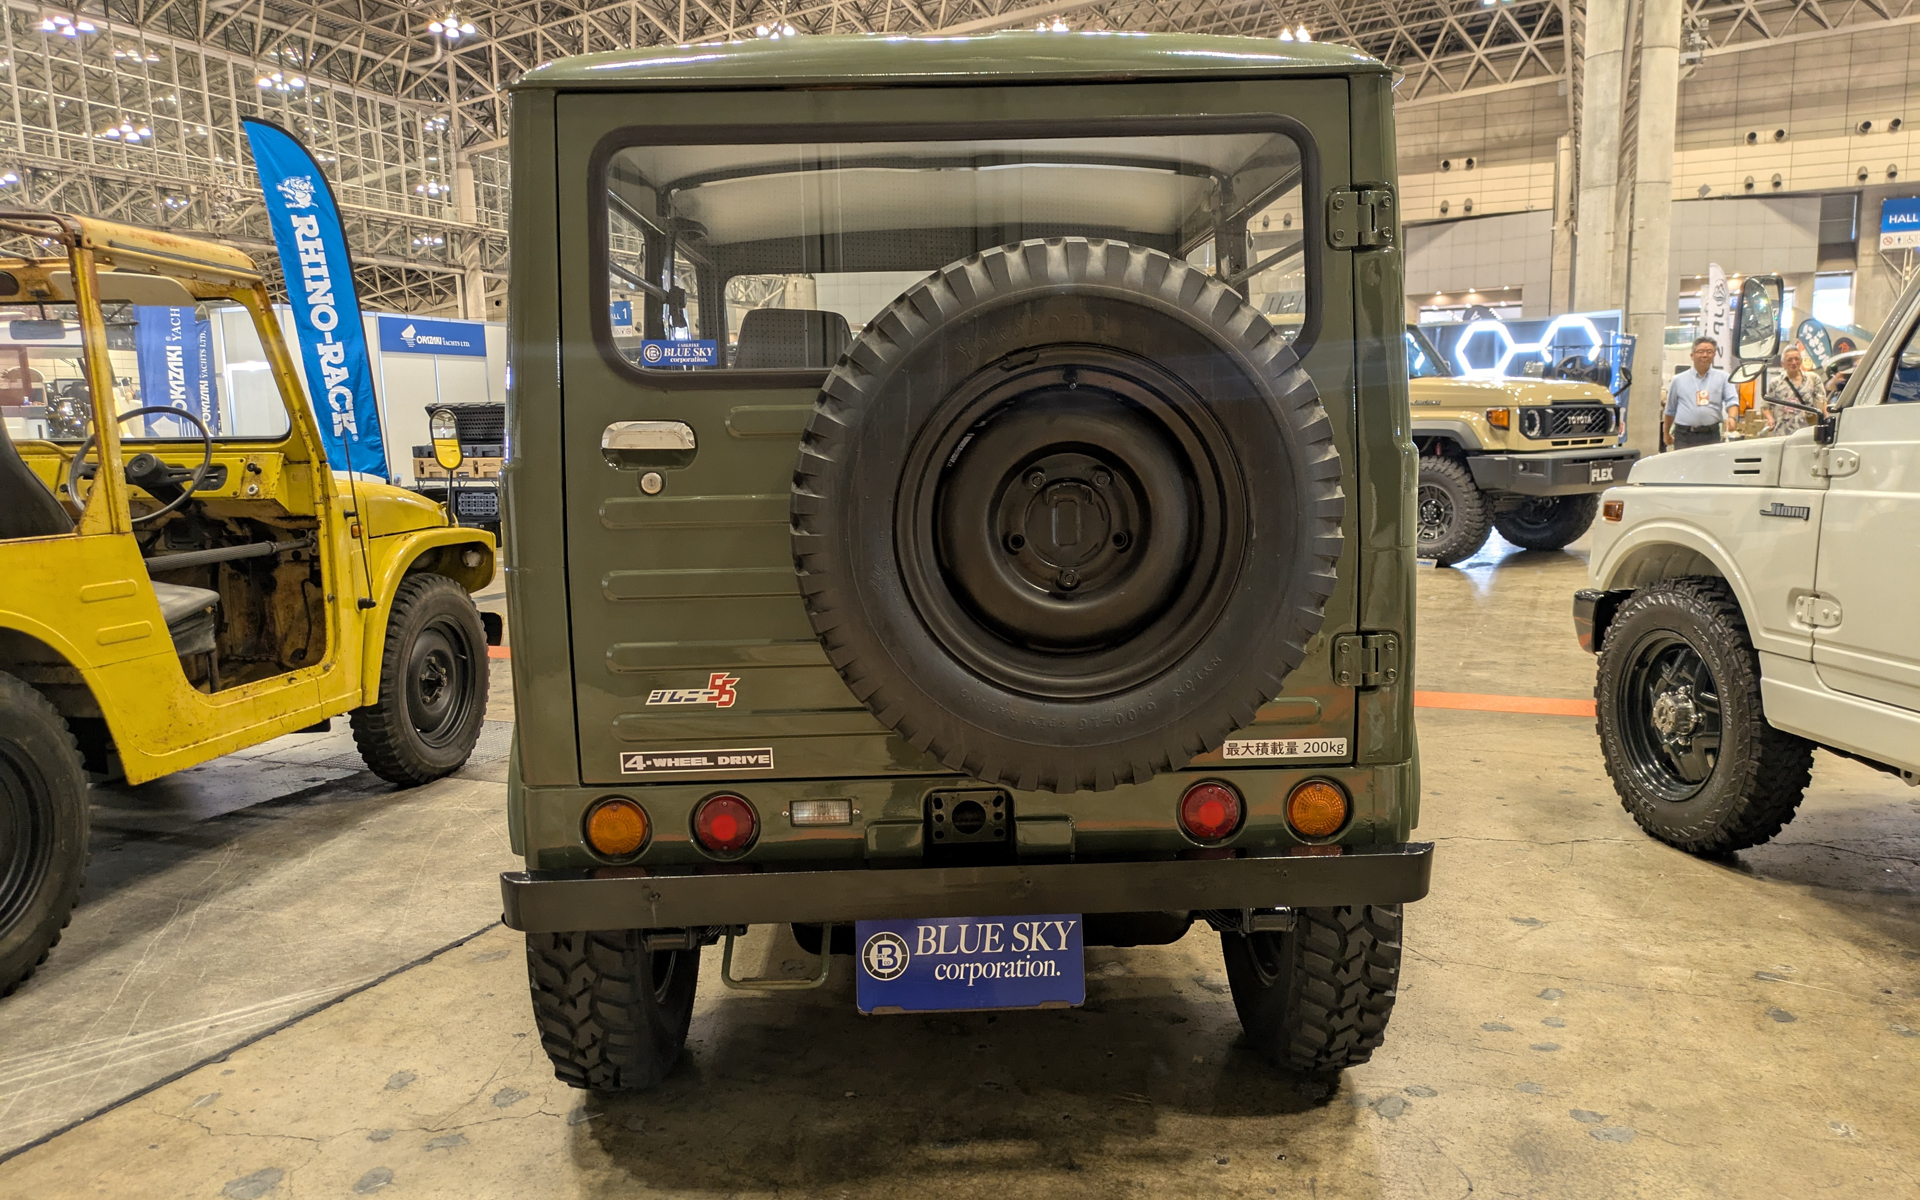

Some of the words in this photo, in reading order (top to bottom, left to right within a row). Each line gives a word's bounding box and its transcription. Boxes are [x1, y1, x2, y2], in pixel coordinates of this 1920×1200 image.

[1889, 214, 1919, 224] HALL
[170, 305, 182, 342] YACH
[290, 214, 357, 438] RHINO-RACK
[664, 347, 691, 357] BLUE
[692, 347, 714, 357] SKY
[1567, 415, 1592, 425] TOYOTA
[1591, 467, 1613, 482] FLEX
[1759, 503, 1811, 521] Jimny
[1226, 741, 1299, 757] 最大積載量
[1303, 741, 1345, 755] 200kg
[718, 754, 770, 765] DRIVE
[914, 923, 1005, 956] BLUE
[1011, 920, 1077, 953] SKY
[934, 954, 1061, 986] corporation.
